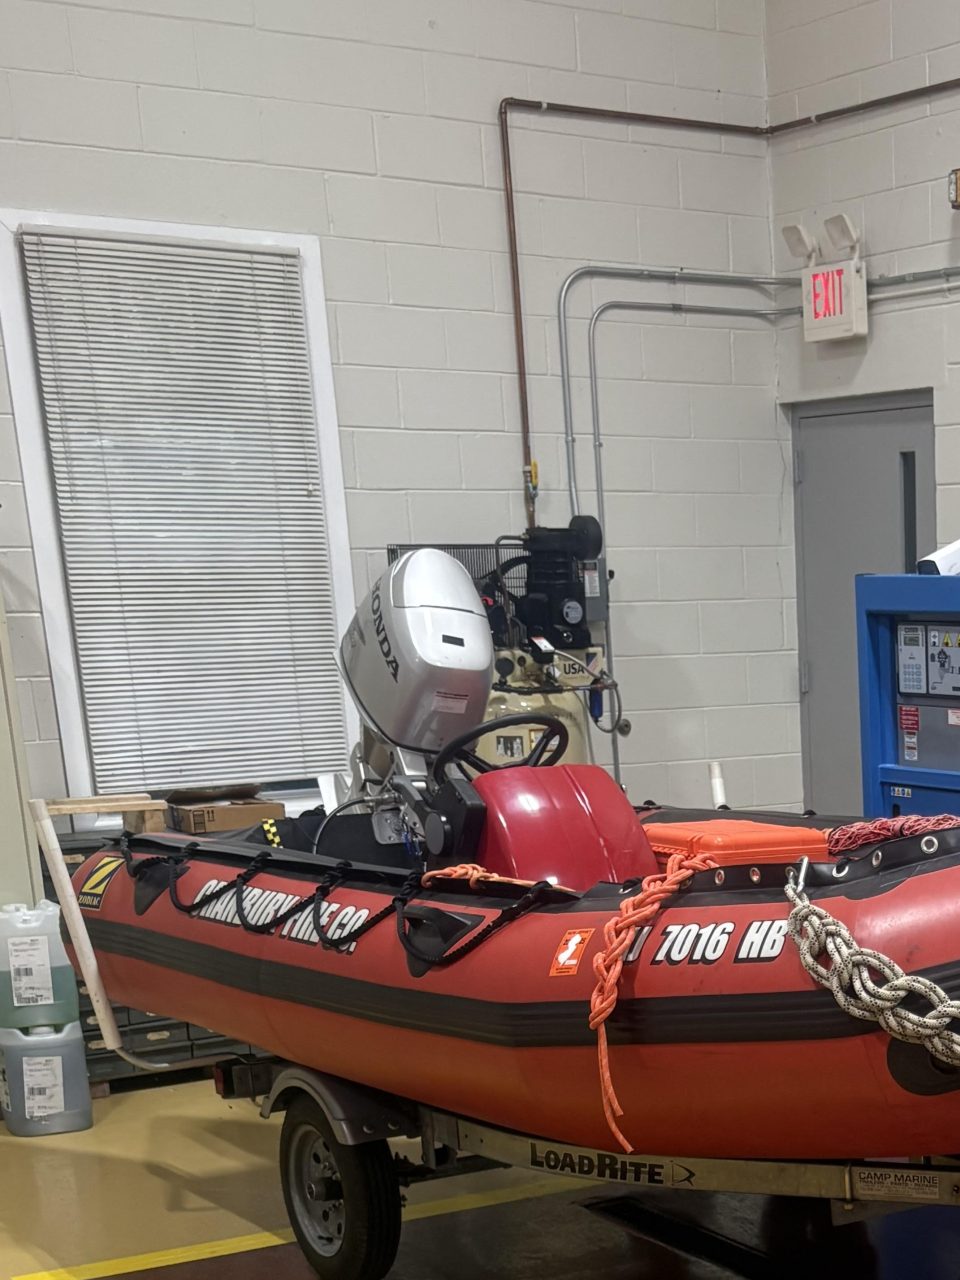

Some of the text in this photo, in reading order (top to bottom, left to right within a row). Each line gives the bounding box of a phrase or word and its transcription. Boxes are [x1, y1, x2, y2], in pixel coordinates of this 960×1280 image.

[811, 268, 844, 320] EXIT
[371, 576, 400, 684] HONDA
[563, 663, 585, 675] USA
[651, 920, 735, 966] 7016
[733, 919, 789, 964] HB
[858, 1171, 938, 1185] CAMP MARINE
